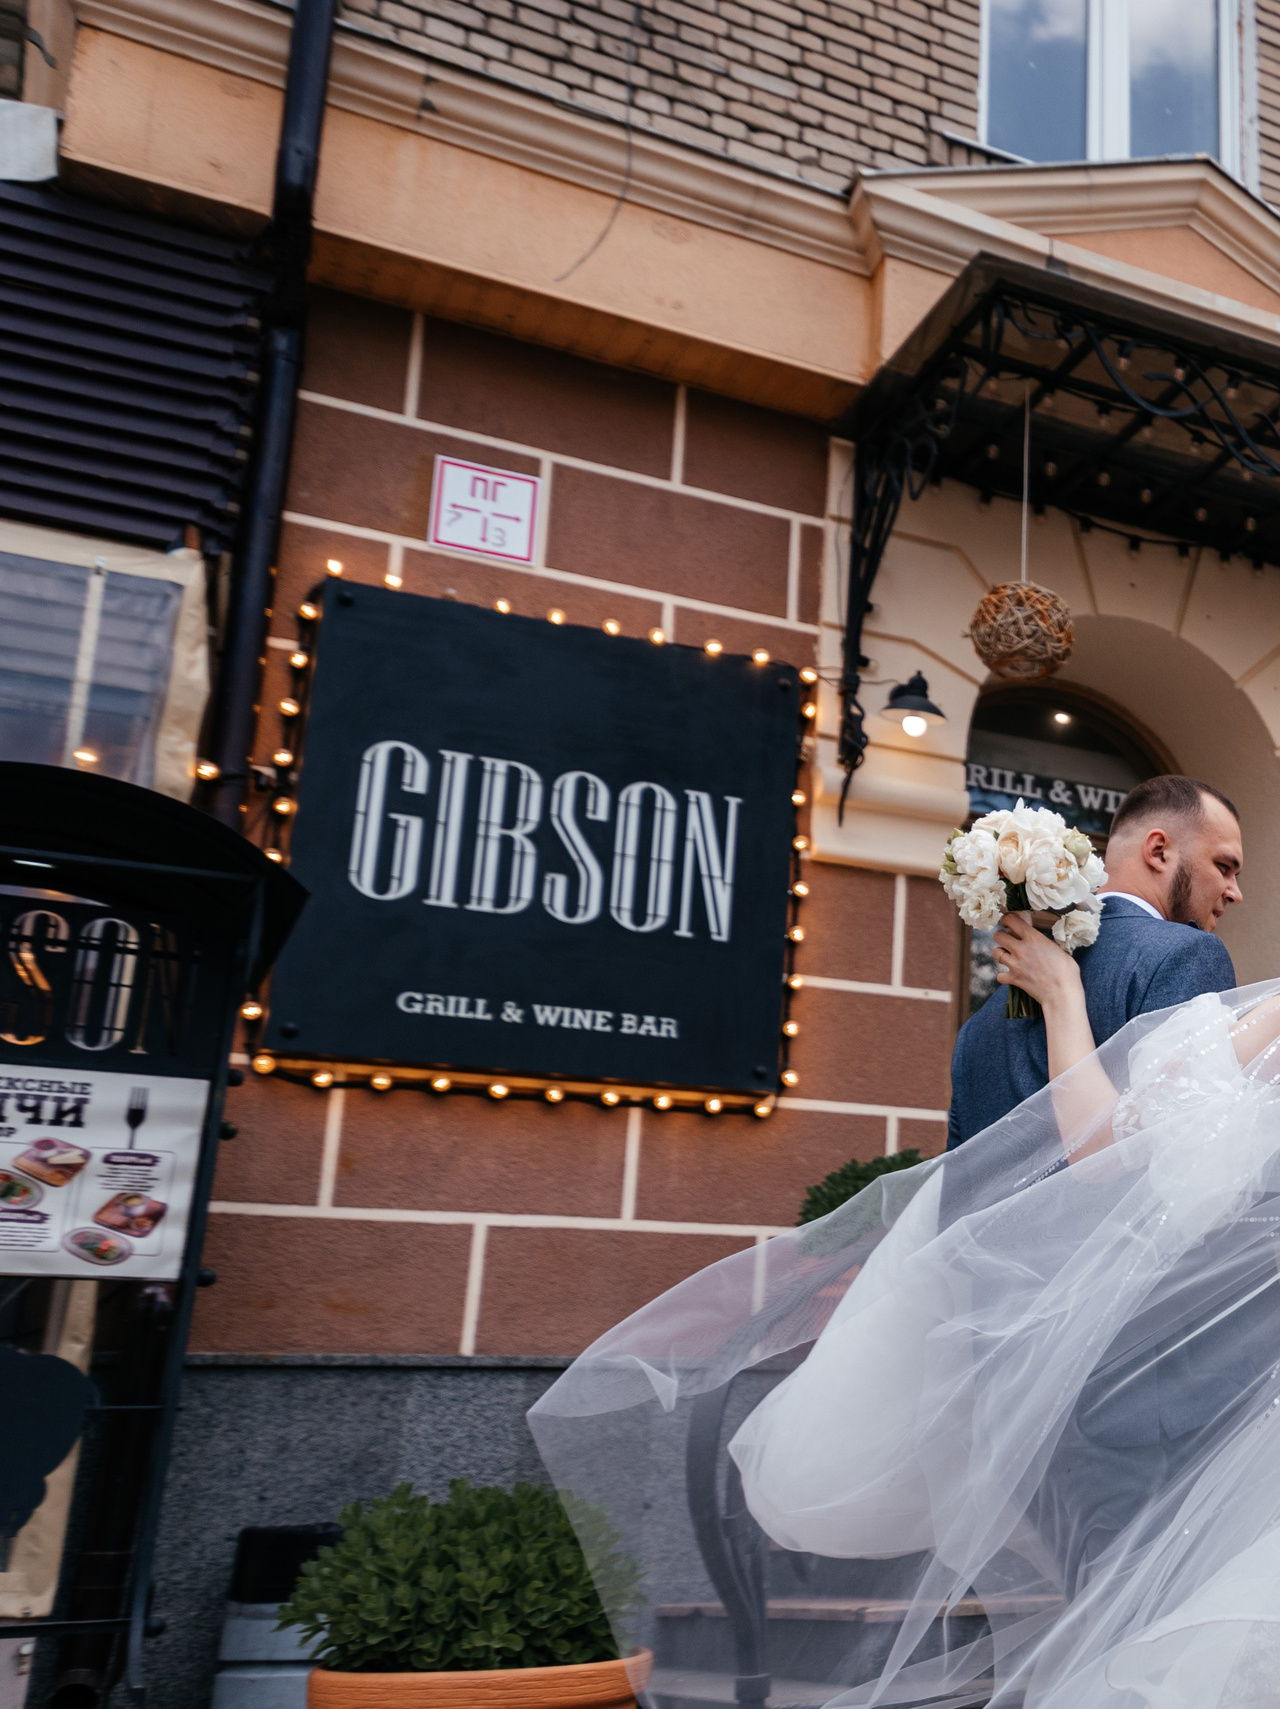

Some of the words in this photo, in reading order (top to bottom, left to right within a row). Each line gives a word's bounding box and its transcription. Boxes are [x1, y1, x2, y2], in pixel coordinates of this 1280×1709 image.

[1050, 780, 1072, 805] &
[1075, 784, 1127, 813] WI
[348, 739, 743, 943] GIBSON
[396, 991, 493, 1022] GRILL
[501, 1001, 524, 1024] &
[533, 1004, 613, 1032] WINE
[620, 1013, 679, 1040] BAR
